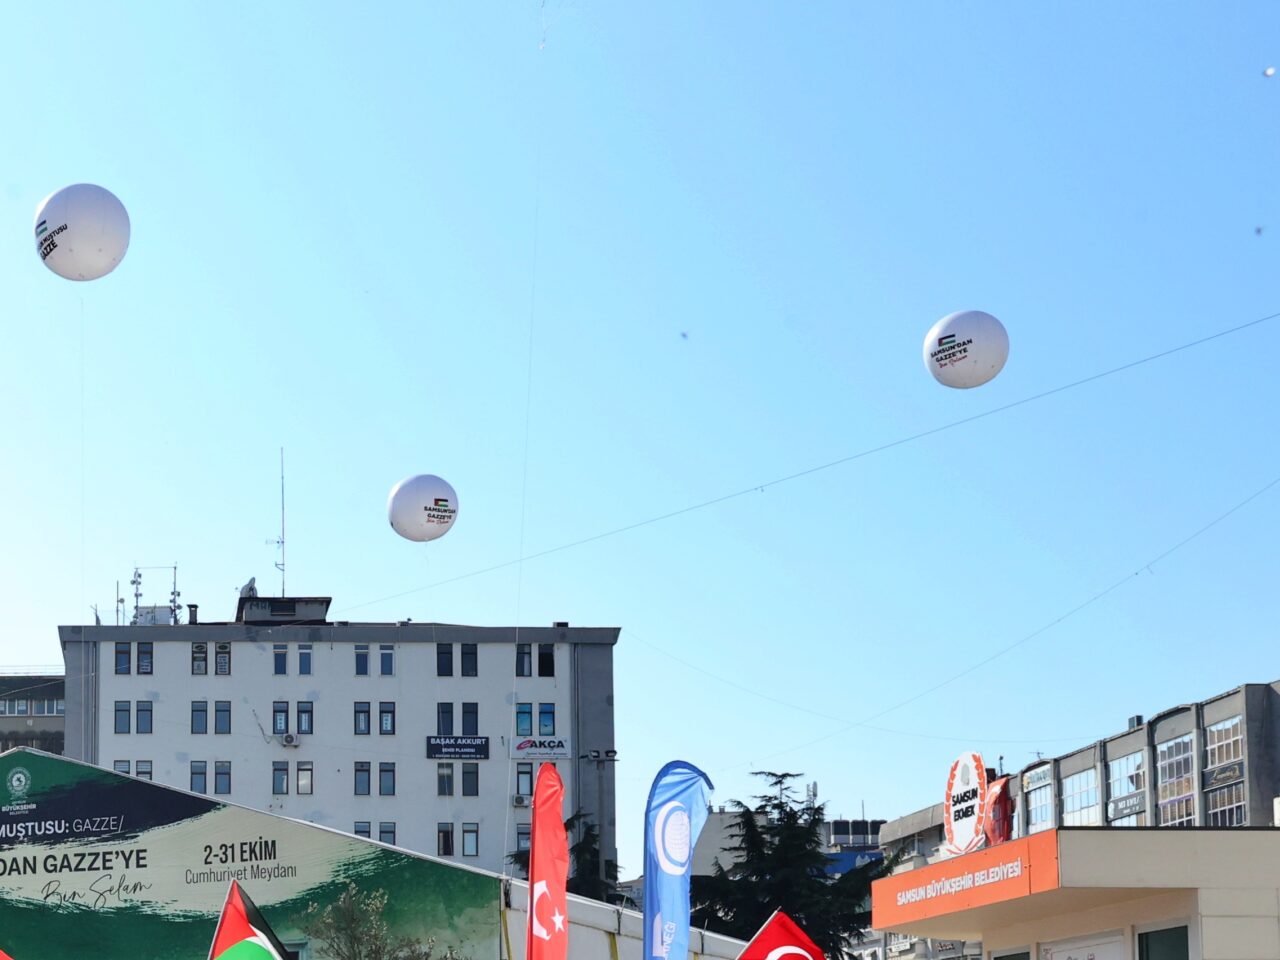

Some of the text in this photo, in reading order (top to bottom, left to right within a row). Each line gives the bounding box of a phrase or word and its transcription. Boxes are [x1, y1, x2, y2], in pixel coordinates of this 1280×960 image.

[951, 787, 978, 807] SAMSUN
[43, 848, 148, 874] GAZZE’YE
[204, 836, 277, 865] 2-31 EKİM
[185, 863, 297, 885] Cumhuriyet Meydanı
[896, 857, 1022, 906] SAMSUN BÜYÜKŞEHİR BELEDİYESİ
[89, 873, 153, 910] Selam
